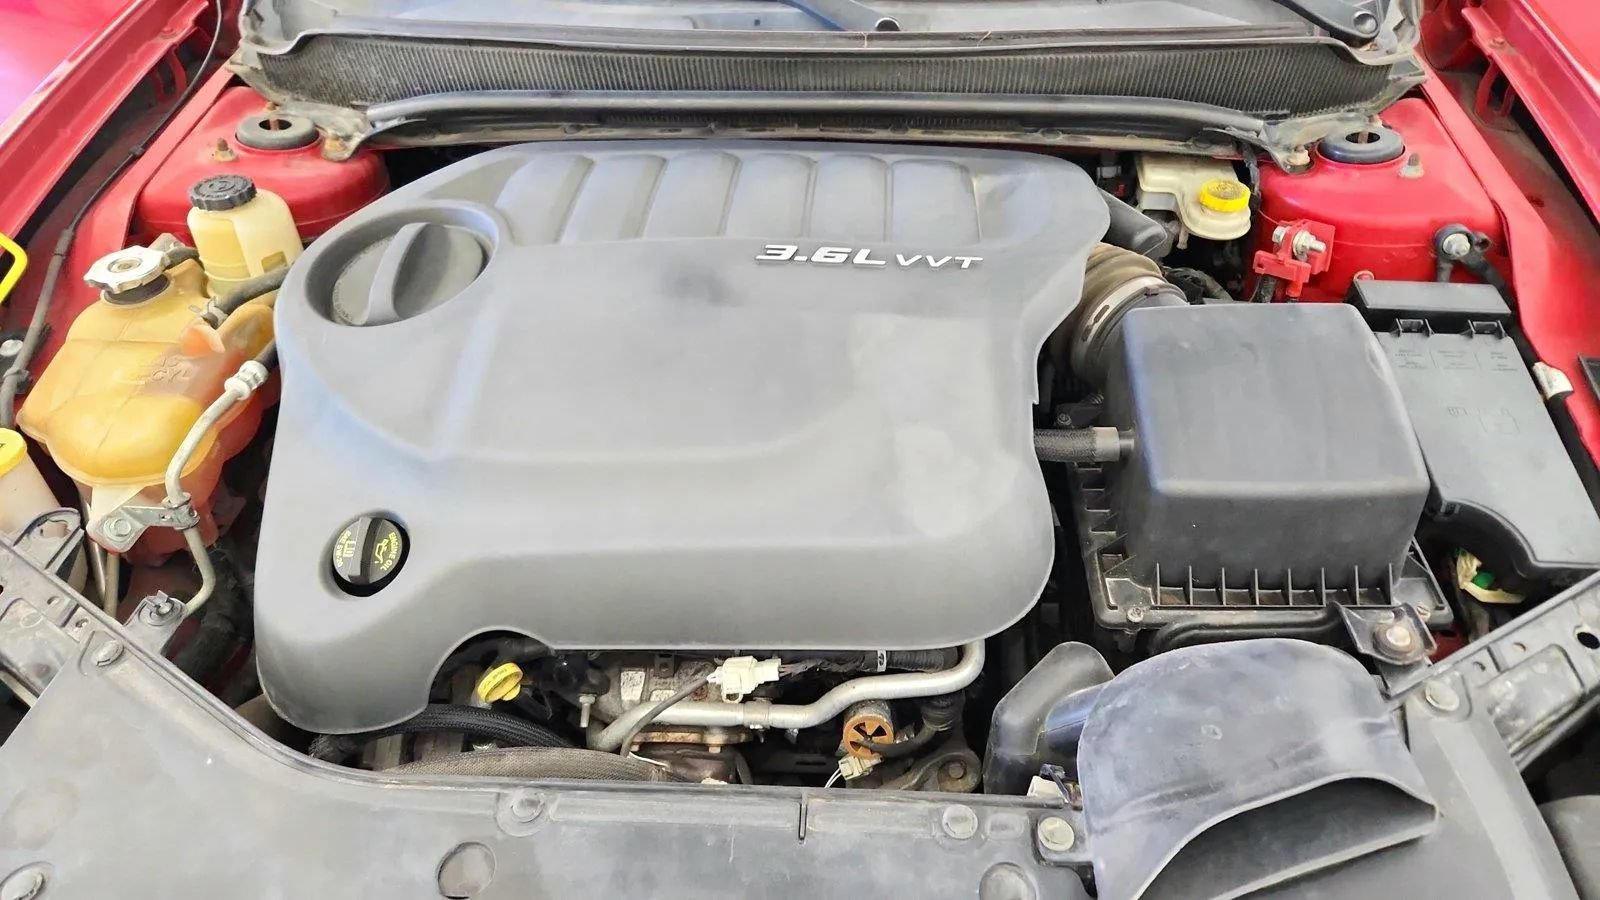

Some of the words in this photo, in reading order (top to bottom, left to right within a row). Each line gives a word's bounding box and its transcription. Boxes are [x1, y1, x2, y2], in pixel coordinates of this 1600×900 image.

[755, 244, 887, 266] 3.6L
[895, 253, 984, 270] VVT
[389, 532, 398, 559] ENGINE
[380, 559, 393, 570] OIL
